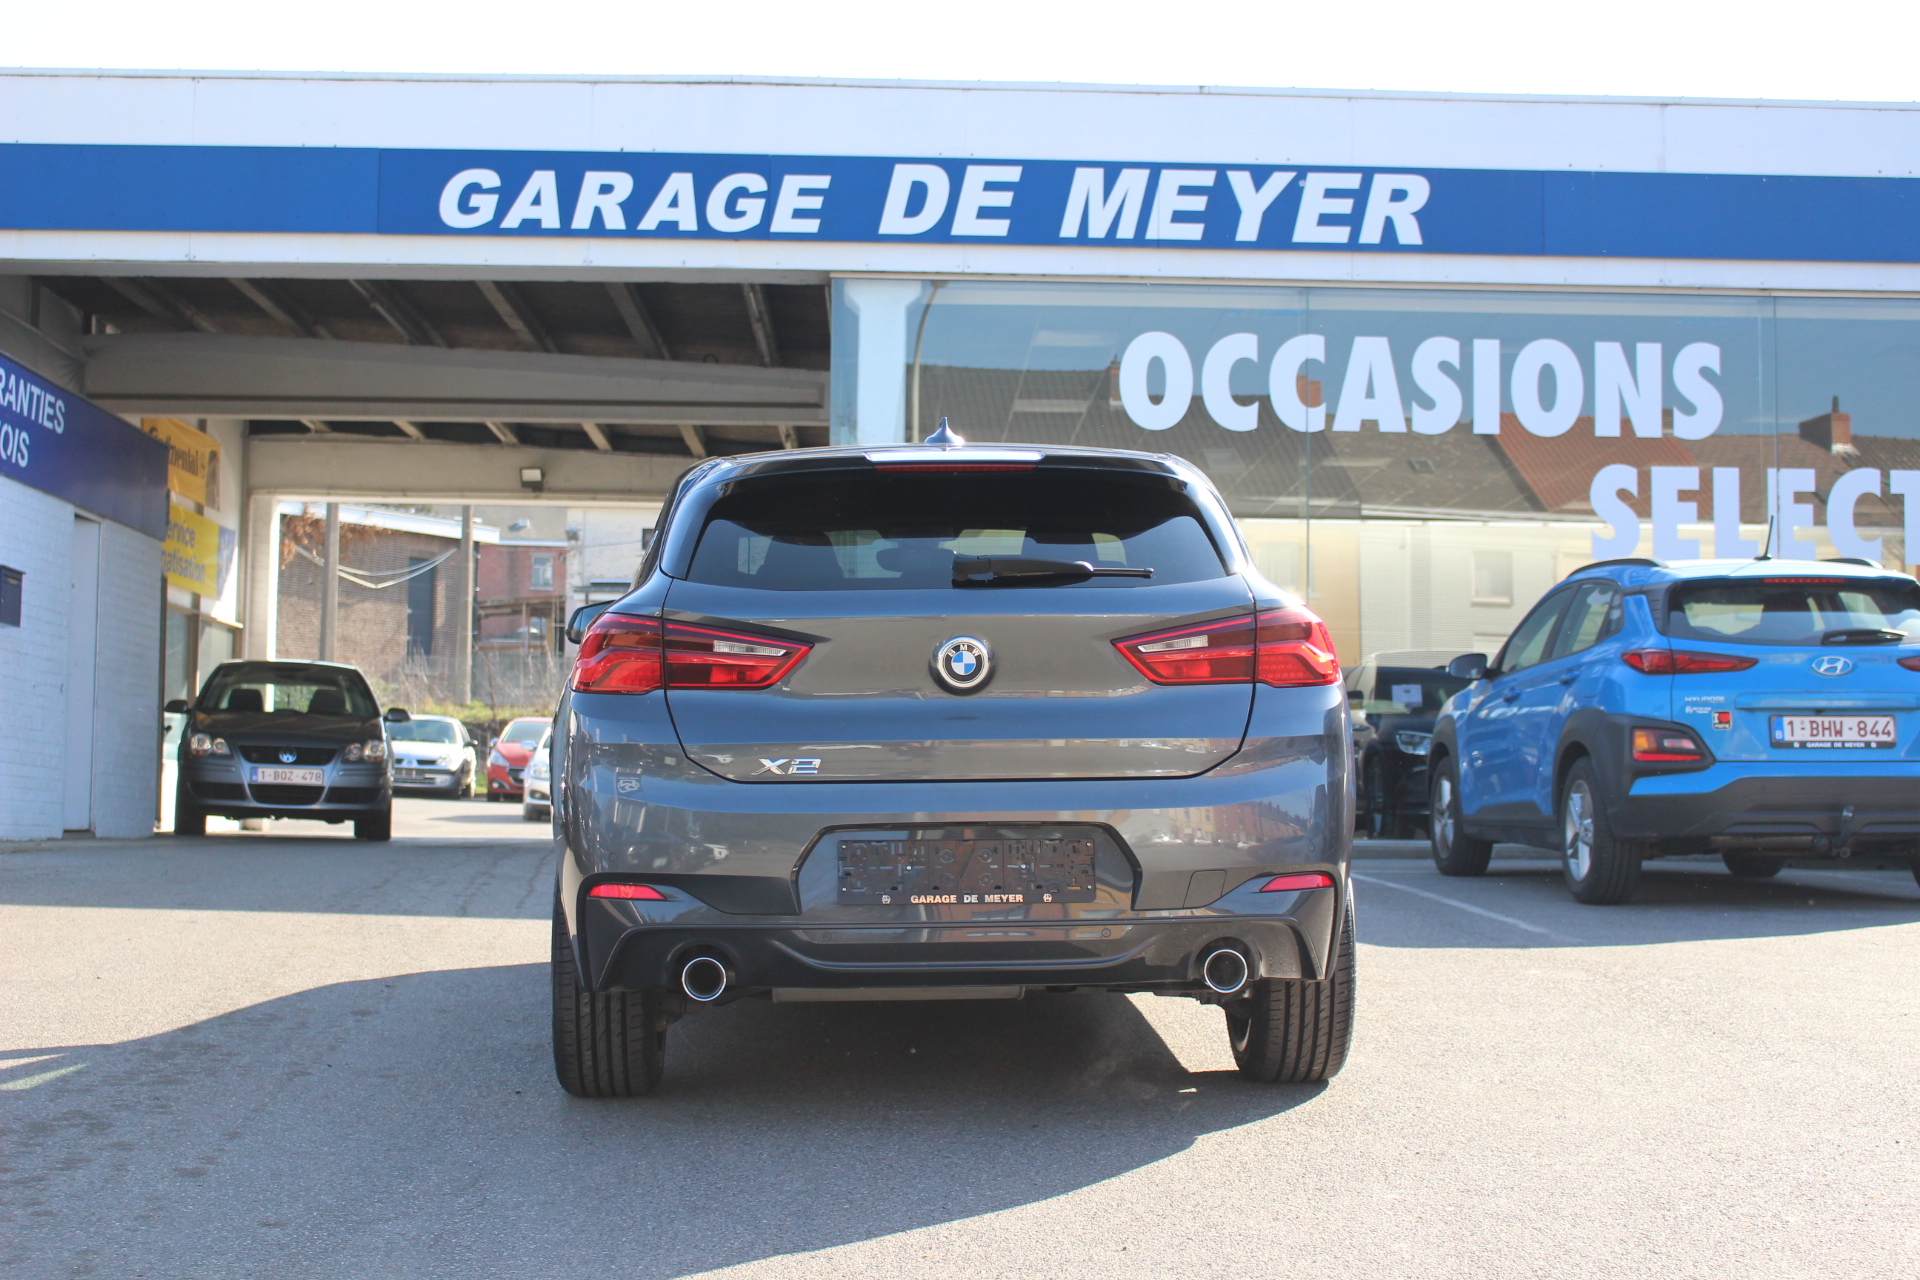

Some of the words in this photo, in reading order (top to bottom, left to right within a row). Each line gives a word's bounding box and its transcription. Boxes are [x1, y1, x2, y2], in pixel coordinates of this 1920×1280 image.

[438, 168, 831, 233] GARAGE
[877, 163, 1022, 237] DE
[1058, 167, 1431, 246] MEYER
[1119, 331, 1722, 440] OCCASIONS
[0, 422, 30, 468] OIS
[167, 519, 195, 548] ervice
[948, 644, 981, 656] BMW
[751, 758, 821, 775] X2
[911, 894, 957, 904] GARAGE
[963, 894, 978, 903] DE
[984, 894, 1024, 903] MEYER
